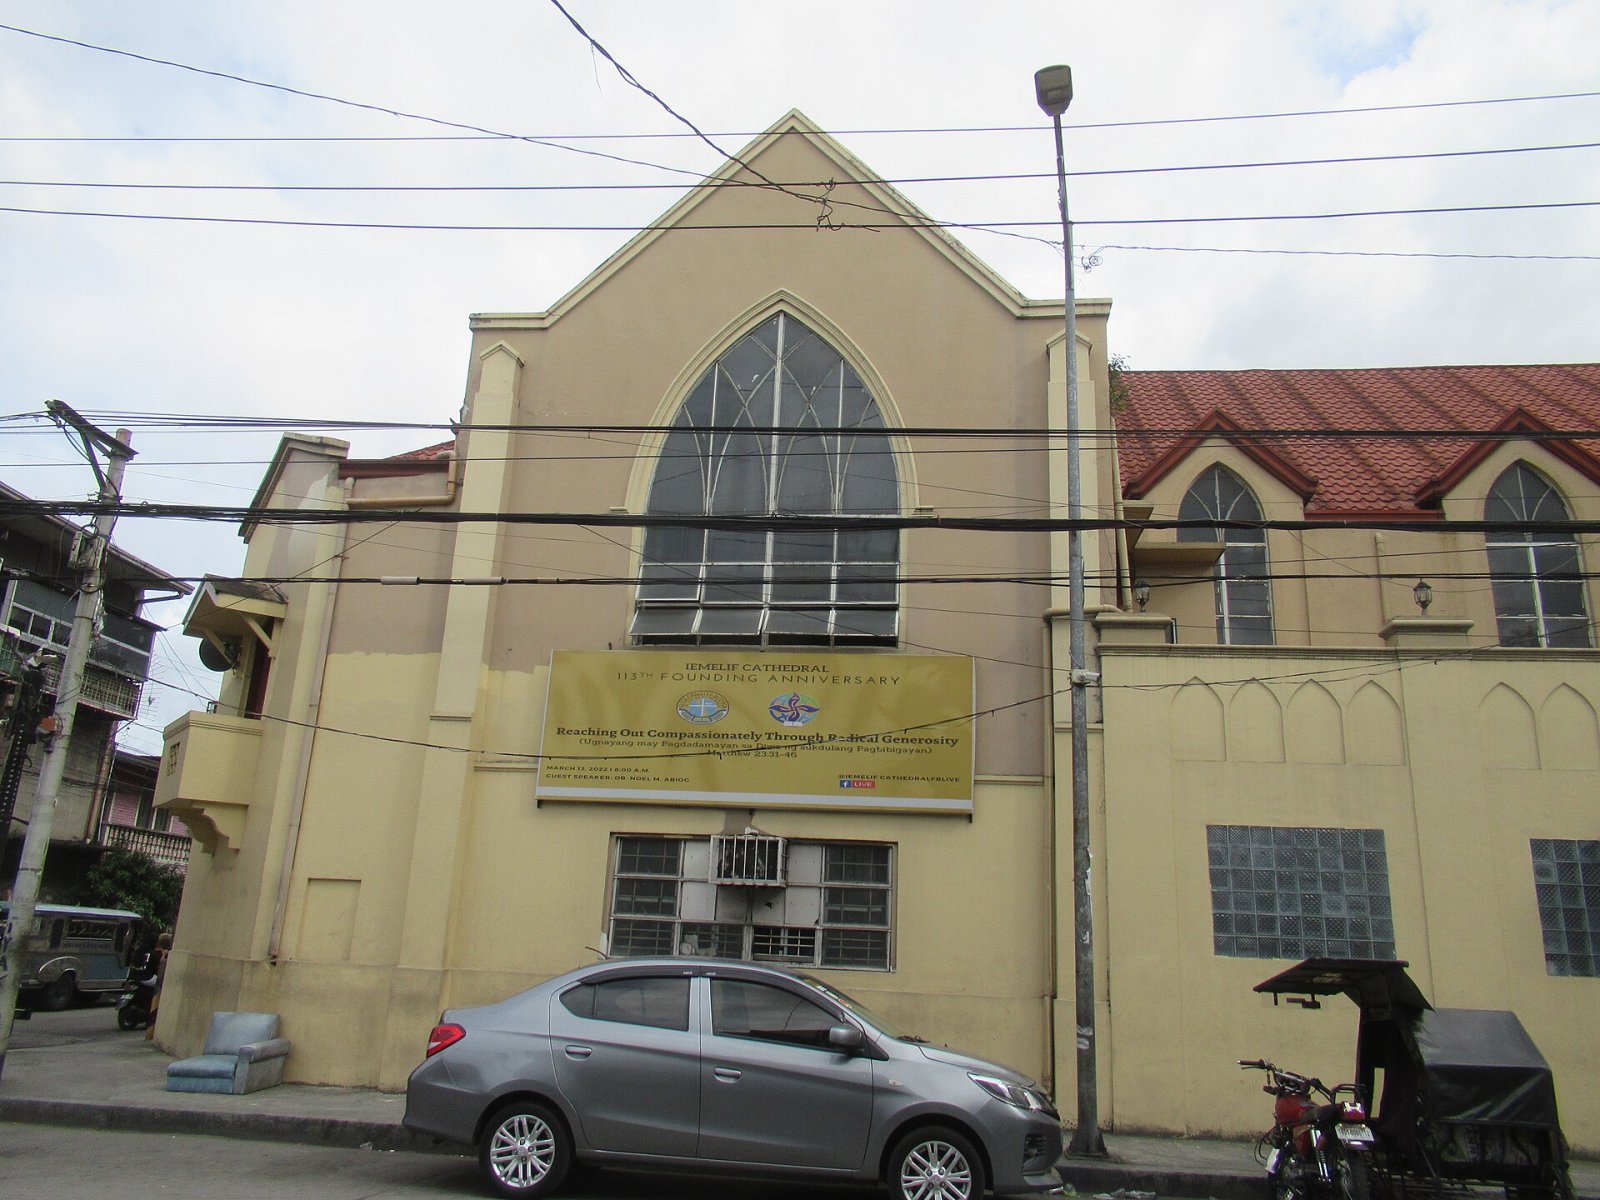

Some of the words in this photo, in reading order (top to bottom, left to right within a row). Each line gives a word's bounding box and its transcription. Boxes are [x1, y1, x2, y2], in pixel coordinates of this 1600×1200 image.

[685, 663, 740, 671] IEMELIF
[742, 664, 830, 673] CATHEDRAL
[660, 673, 758, 683] FOUNDING
[768, 675, 901, 685] ANNIVERSARY
[556, 727, 617, 738] Reaching
[620, 728, 645, 737] Out
[647, 729, 763, 742] Compassionately
[765, 732, 825, 744] Through
[881, 735, 959, 747] Generosity
[579, 738, 634, 747] (Ugnayang
[637, 740, 658, 748] may
[661, 740, 739, 749] Pagdadamayan
[800, 744, 854, 753] sukdulang
